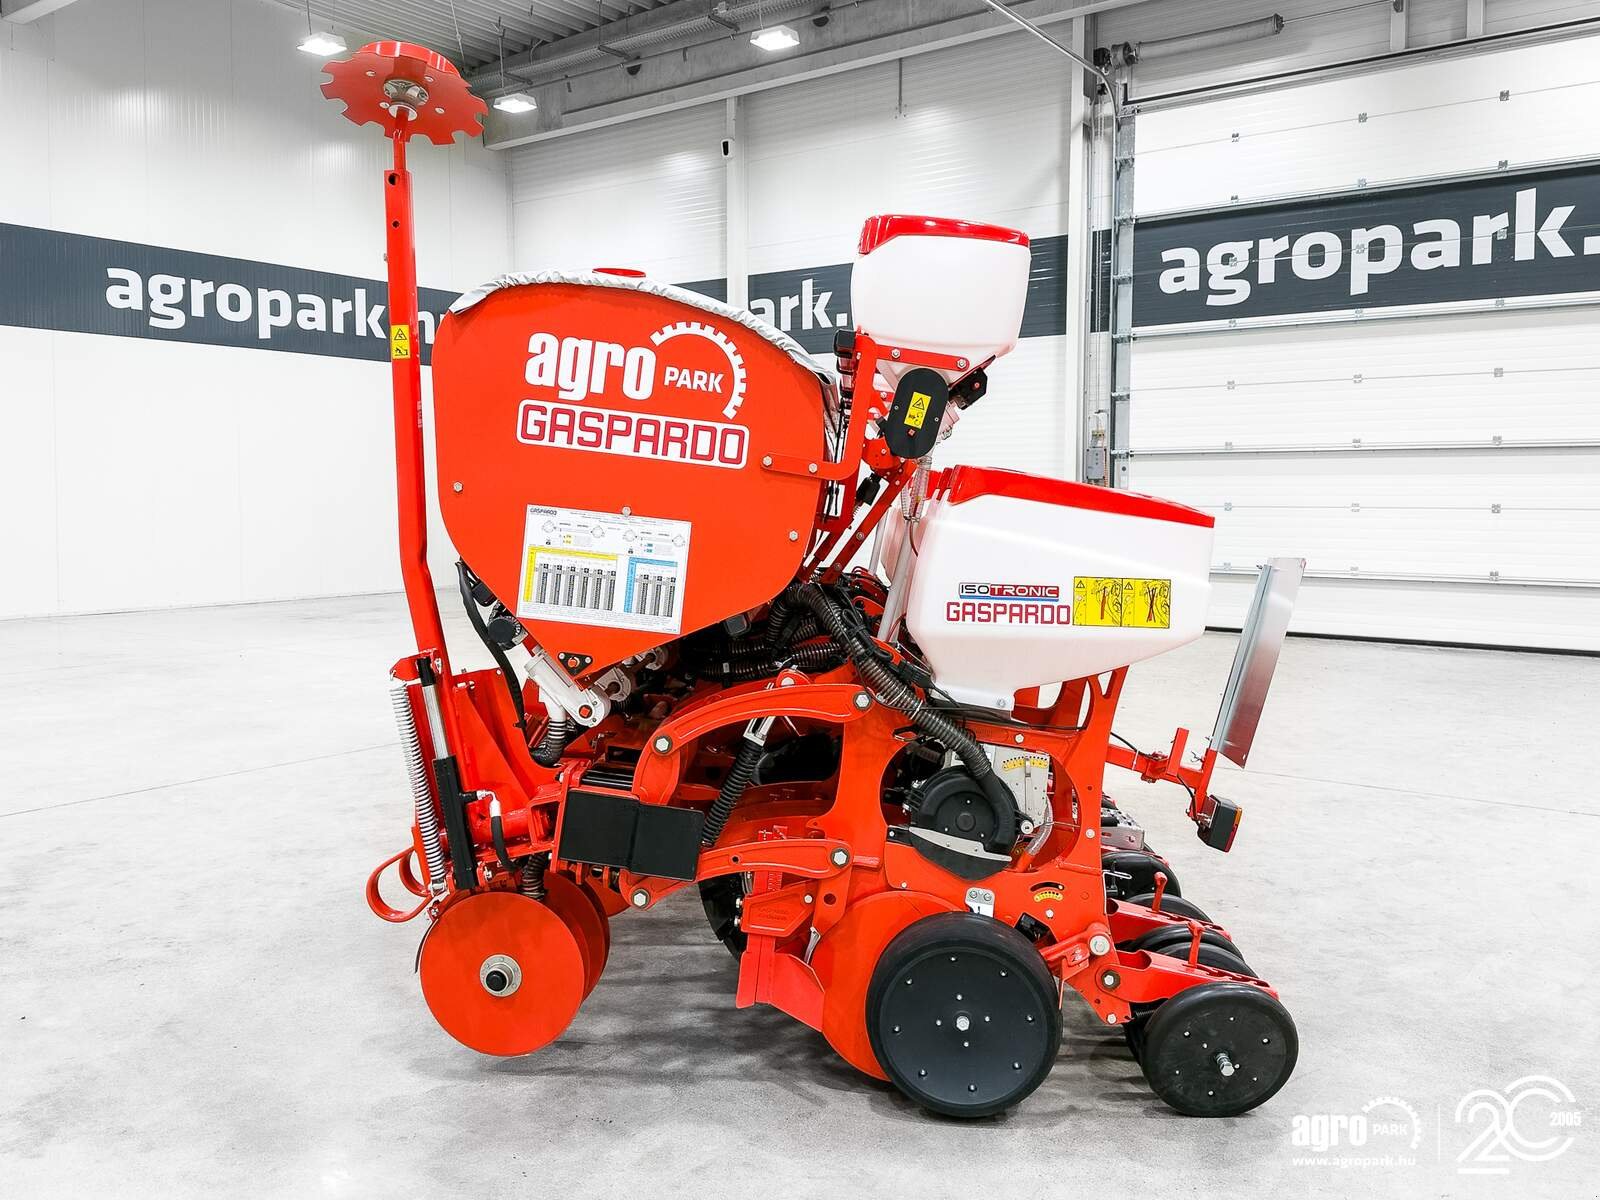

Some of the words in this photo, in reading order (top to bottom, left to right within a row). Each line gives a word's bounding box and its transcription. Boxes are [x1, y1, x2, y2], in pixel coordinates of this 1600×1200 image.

[524, 332, 657, 401] agro
[663, 366, 724, 394] PARK
[520, 404, 746, 465] GASPARDO
[946, 601, 1071, 625] GASPARDO
